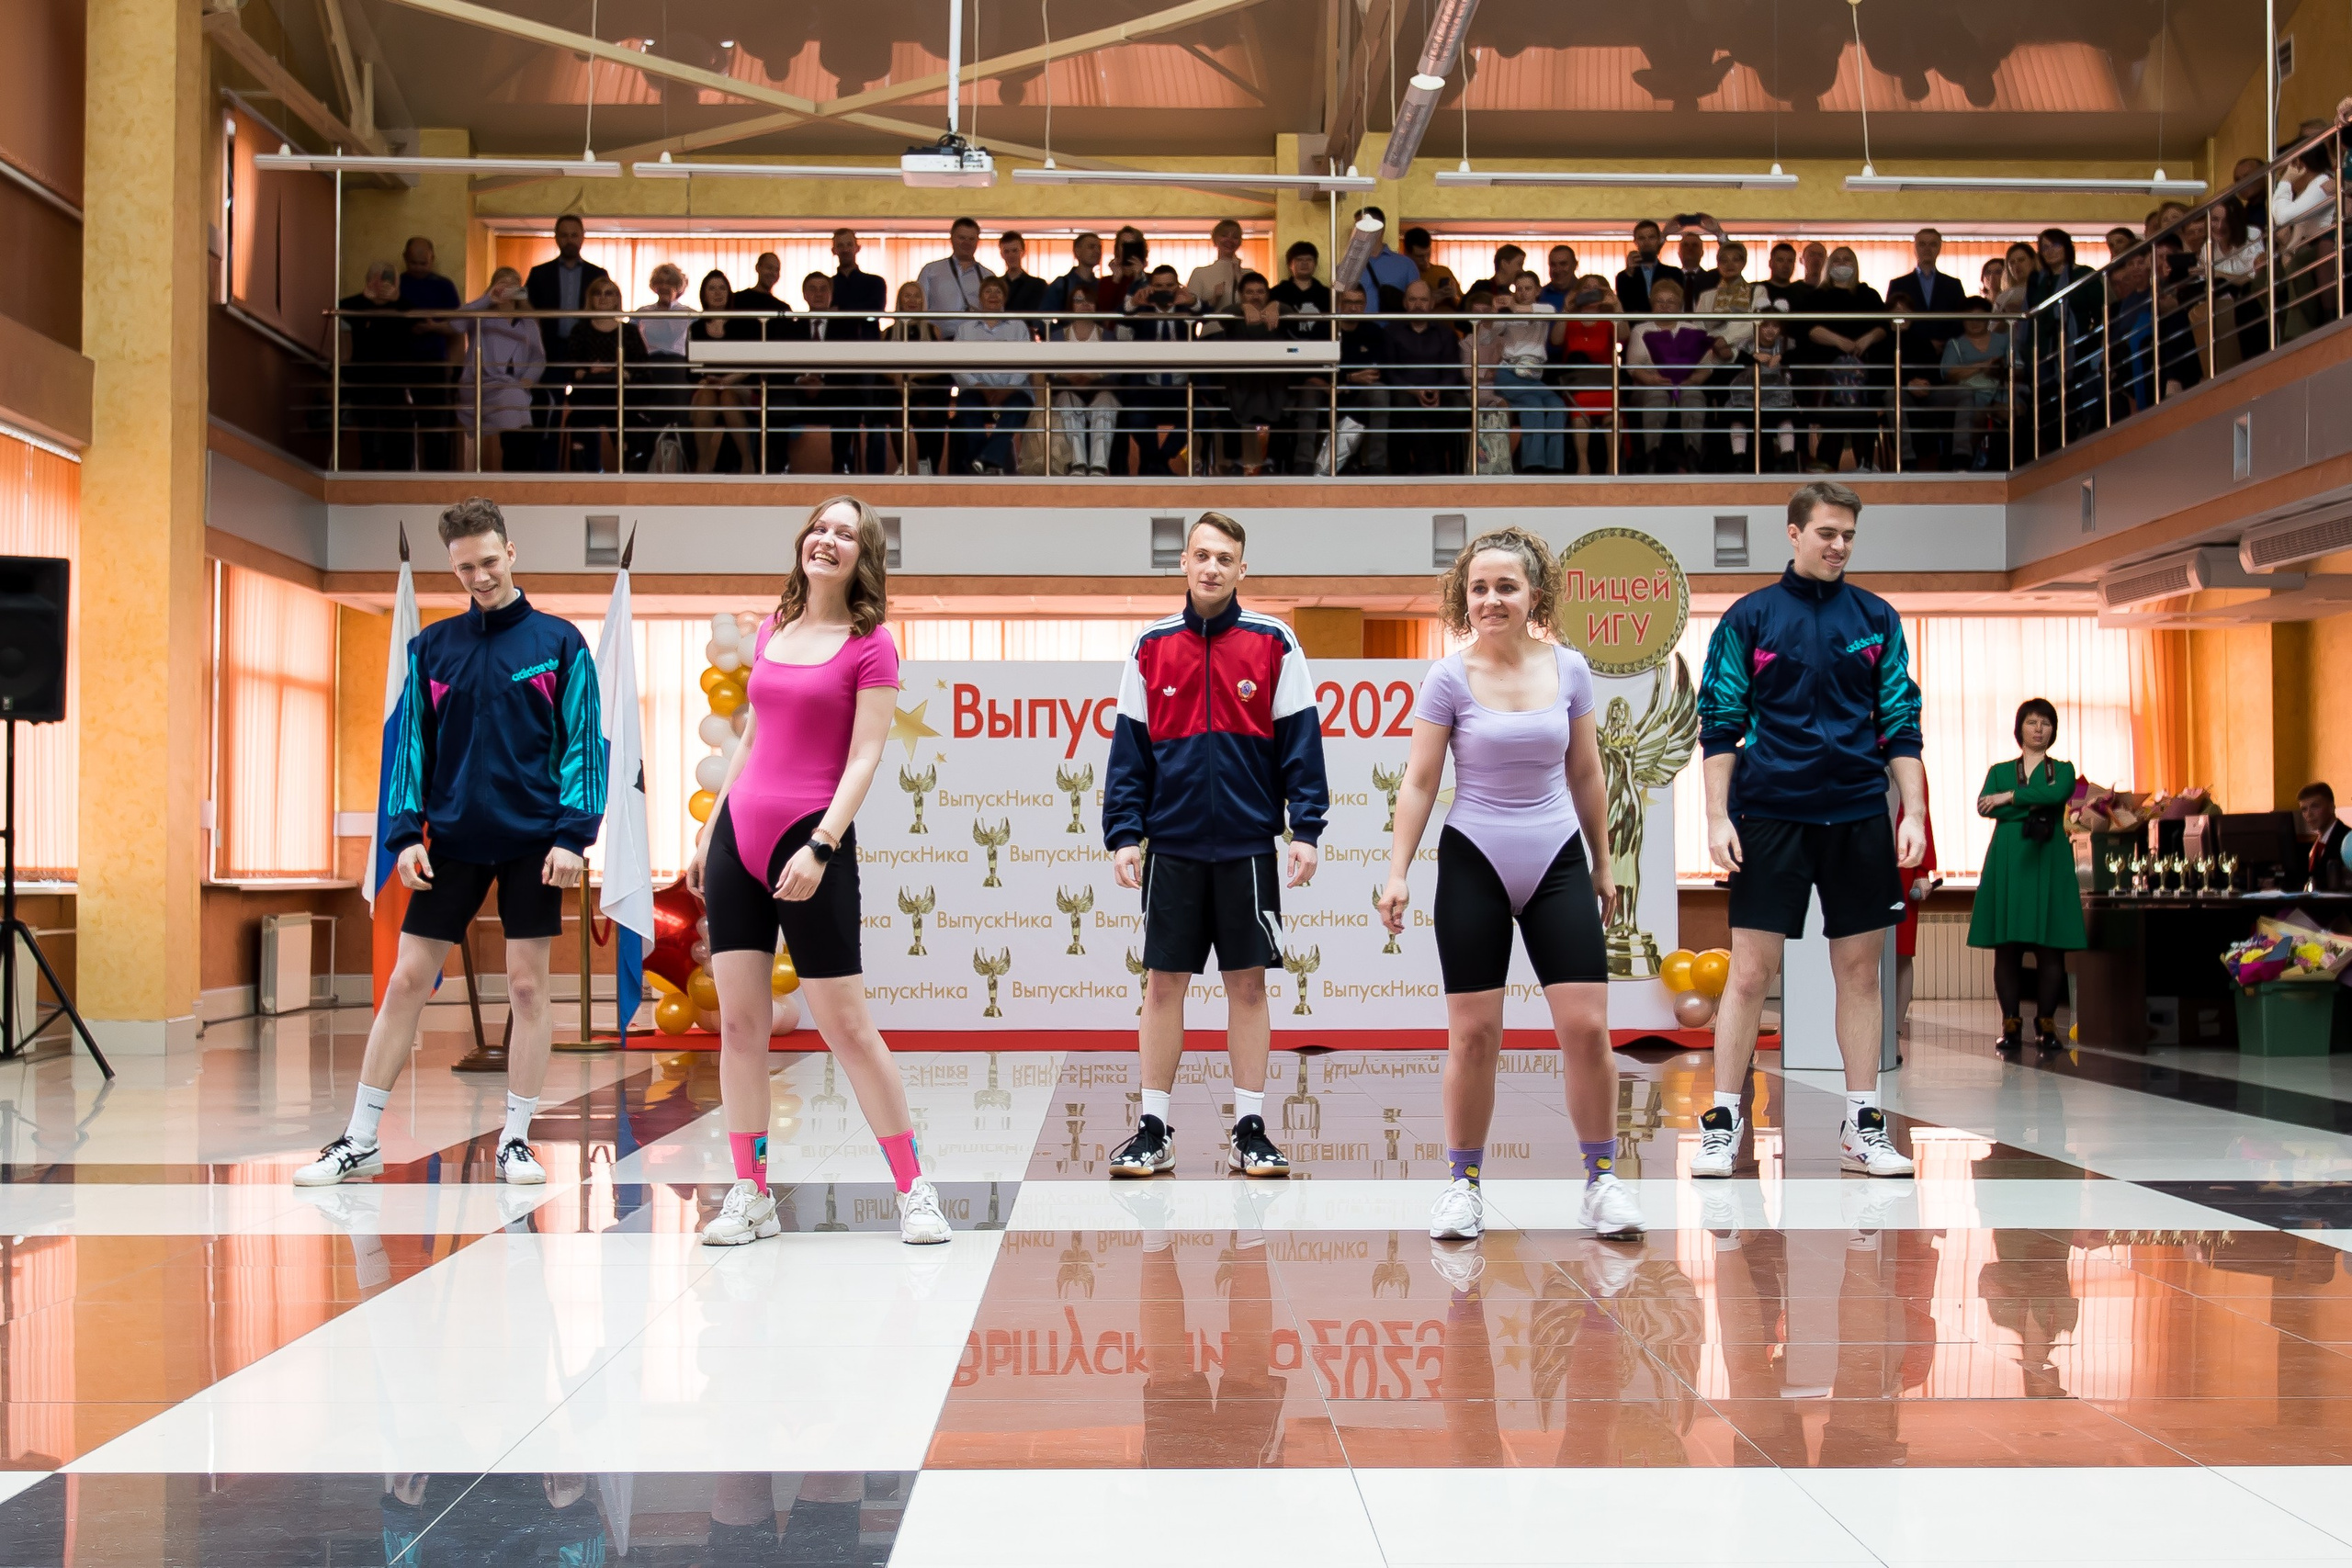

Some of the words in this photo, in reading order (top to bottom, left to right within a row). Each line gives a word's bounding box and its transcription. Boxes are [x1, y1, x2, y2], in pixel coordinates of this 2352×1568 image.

[1564, 570, 1671, 606] Лицей
[1588, 612, 1652, 647] ИГУ
[512, 663, 547, 682] adidas
[954, 683, 1118, 760] Выпус
[1315, 681, 1423, 739] 202
[938, 789, 1055, 813] ВыпускНика
[1010, 844, 1116, 868] ВыпускНик
[1325, 845, 1439, 868] Выпускка
[937, 911, 1053, 934] ВыпускНика
[1281, 909, 1369, 934] пускНика
[865, 982, 968, 1006] ыпускНика
[1012, 981, 1128, 1004] ВыпускНика
[1323, 980, 1439, 1003] ВыпускНика
